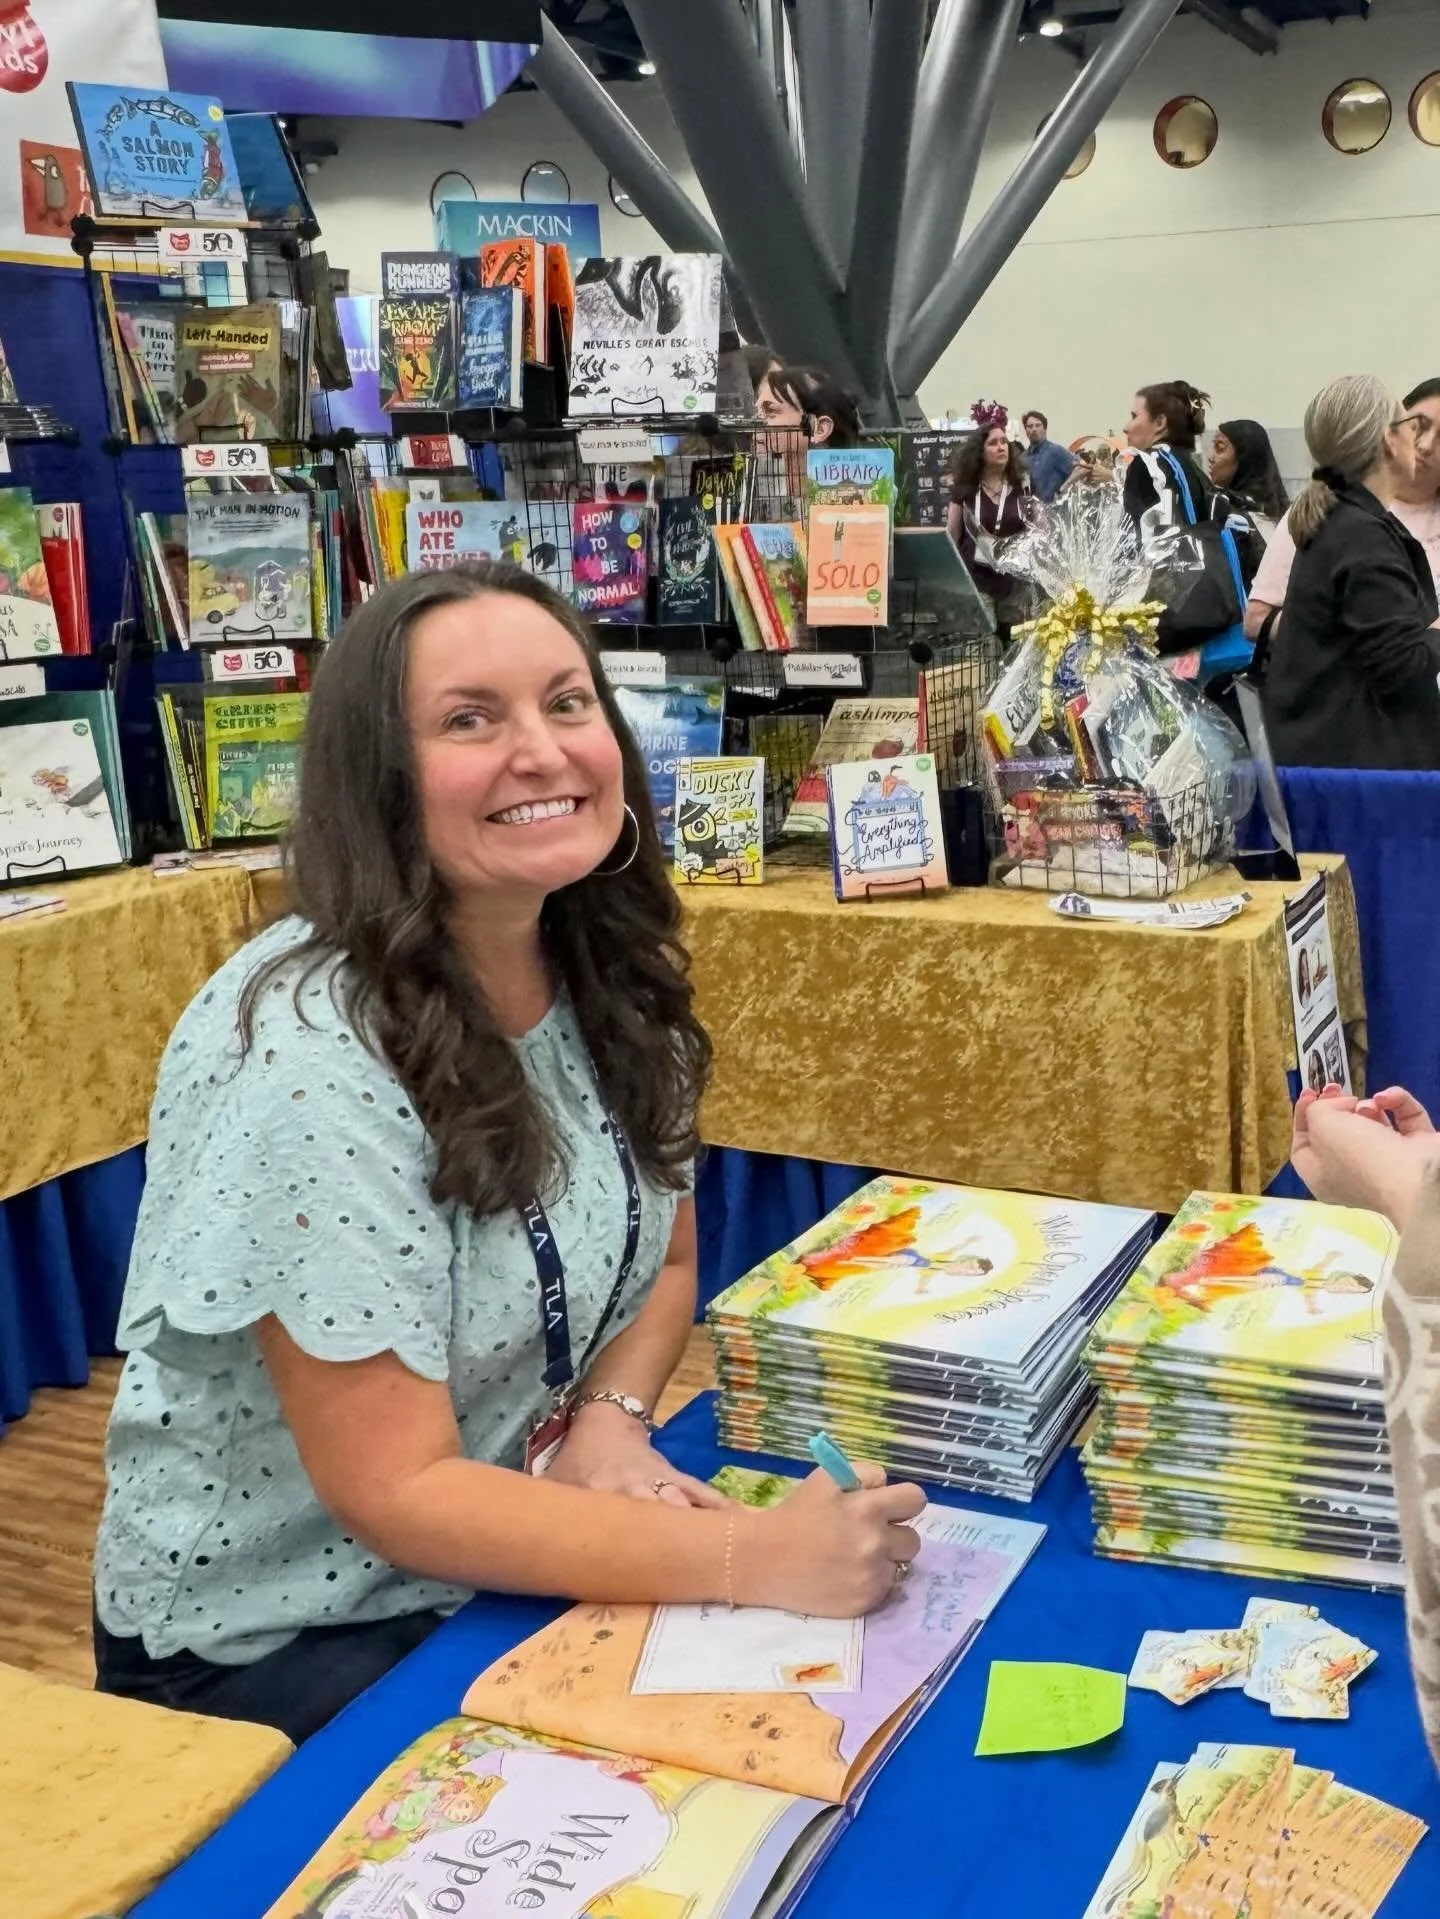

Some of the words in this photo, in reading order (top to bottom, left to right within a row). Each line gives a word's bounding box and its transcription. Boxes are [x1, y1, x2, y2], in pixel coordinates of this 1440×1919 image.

[150, 120, 162, 138] A
[122, 136, 195, 158] SALMON
[134, 155, 191, 175] STORY
[477, 214, 572, 237] MACKIN
[387, 262, 451, 276] DUNGEON
[388, 275, 452, 290] RUNNERS
[186, 327, 269, 345] Left-Handed
[635, 339, 666, 349] GREAT
[227, 447, 257, 467] 50
[601, 465, 628, 482] THE
[815, 463, 884, 481] LIBRARY
[418, 510, 464, 529] WHO
[582, 510, 613, 529] HOW
[419, 532, 455, 550] ATE
[590, 537, 608, 552] TO
[601, 560, 619, 575] BE
[814, 562, 880, 591] SOLO
[577, 582, 638, 603] NORMAL
[254, 650, 283, 670] 50
[693, 769, 755, 795] DUCKY
[730, 791, 755, 809] SPY
[860, 815, 918, 844] Everything
[860, 829, 923, 865] Amplified
[620, 1183, 641, 1232] TLA
[545, 1277, 564, 1330] TLA
[505, 1813, 630, 1909] Wide
